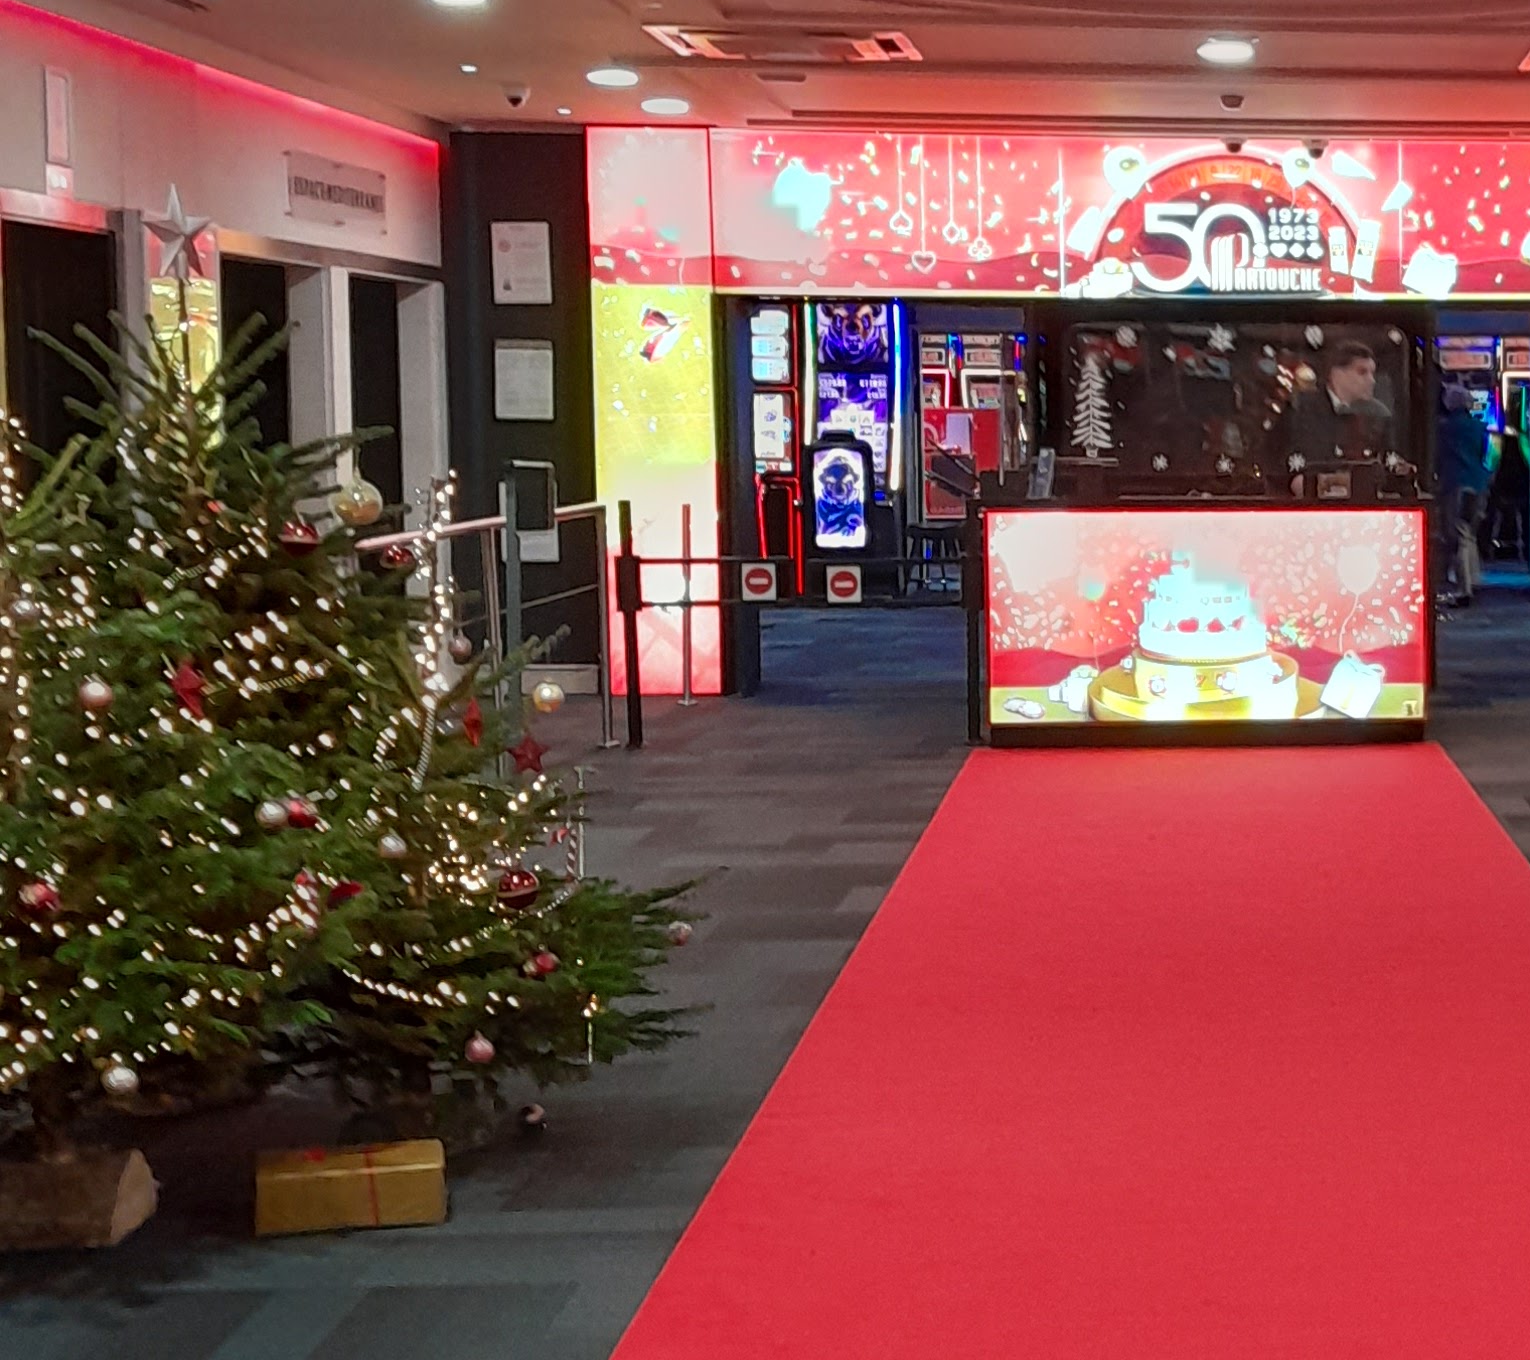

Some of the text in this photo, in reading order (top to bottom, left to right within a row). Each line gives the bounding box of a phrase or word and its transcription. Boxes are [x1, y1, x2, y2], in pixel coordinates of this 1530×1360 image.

[1268, 207, 1319, 225] 1973
[1268, 225, 1320, 241] 2023
[1130, 202, 1268, 293] 50
